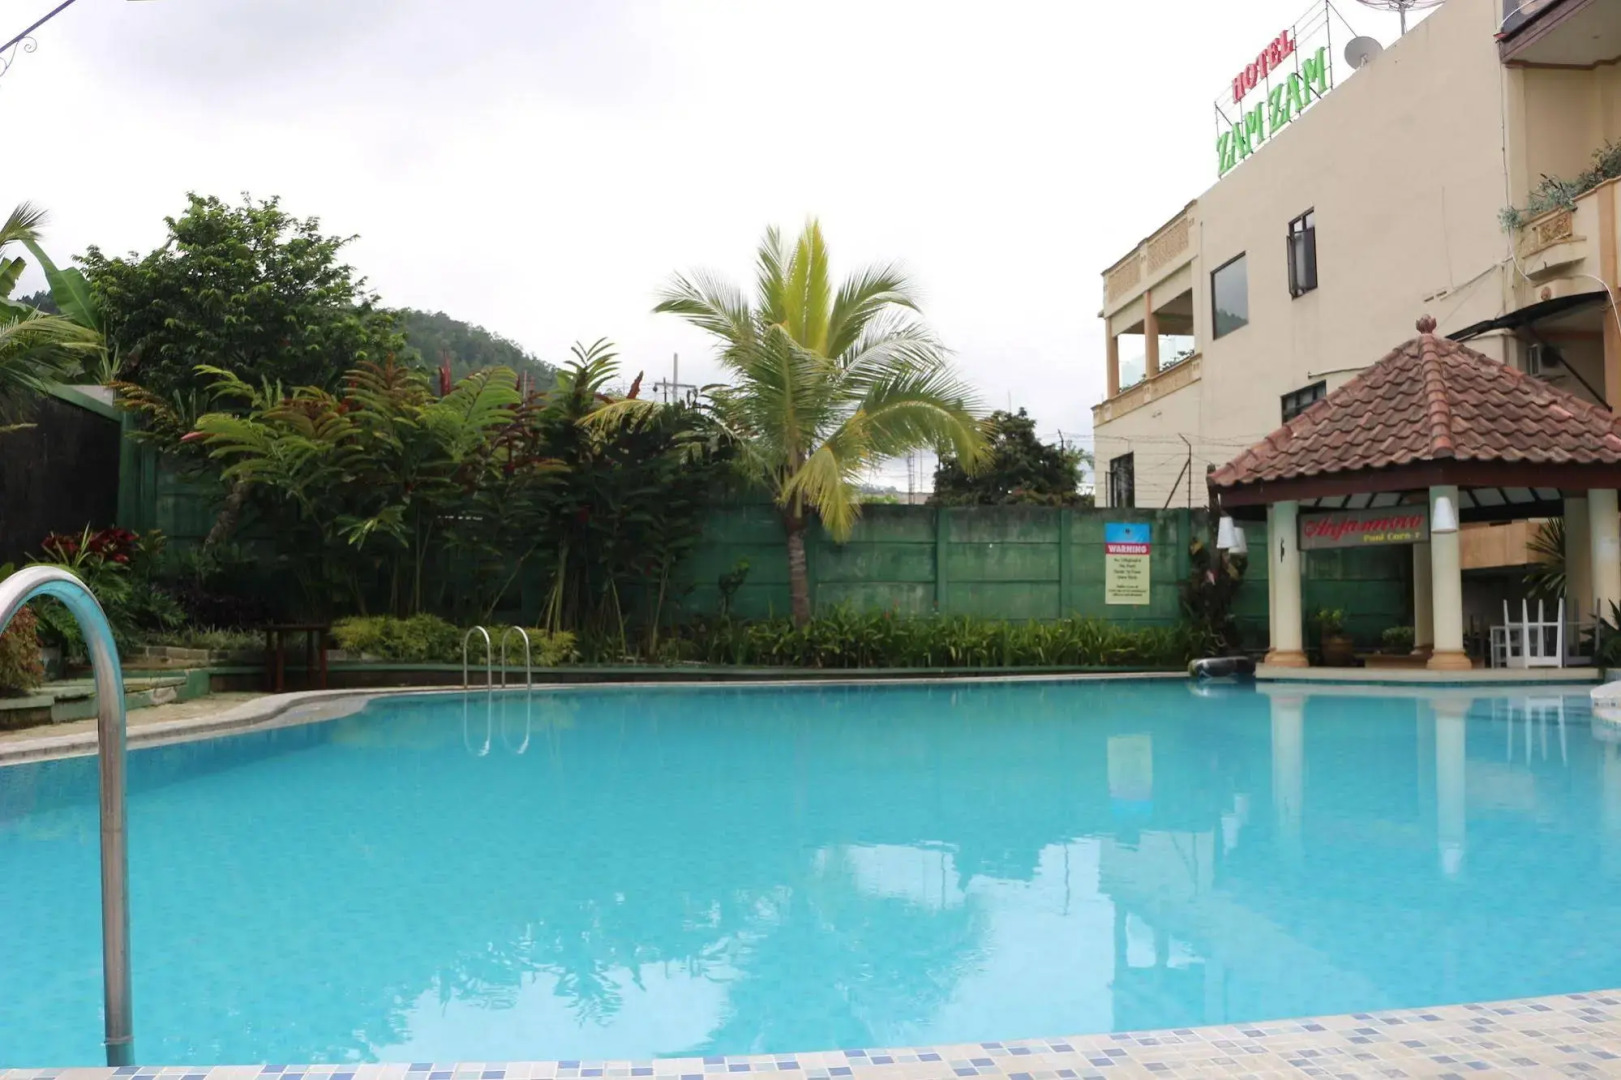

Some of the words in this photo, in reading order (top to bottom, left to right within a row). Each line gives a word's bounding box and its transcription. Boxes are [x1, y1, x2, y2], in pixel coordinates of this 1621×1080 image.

[1232, 30, 1296, 104] HOTEL
[1216, 102, 1266, 176] ZAM
[1268, 46, 1328, 133] ZAM
[1108, 544, 1147, 554] WARNING
